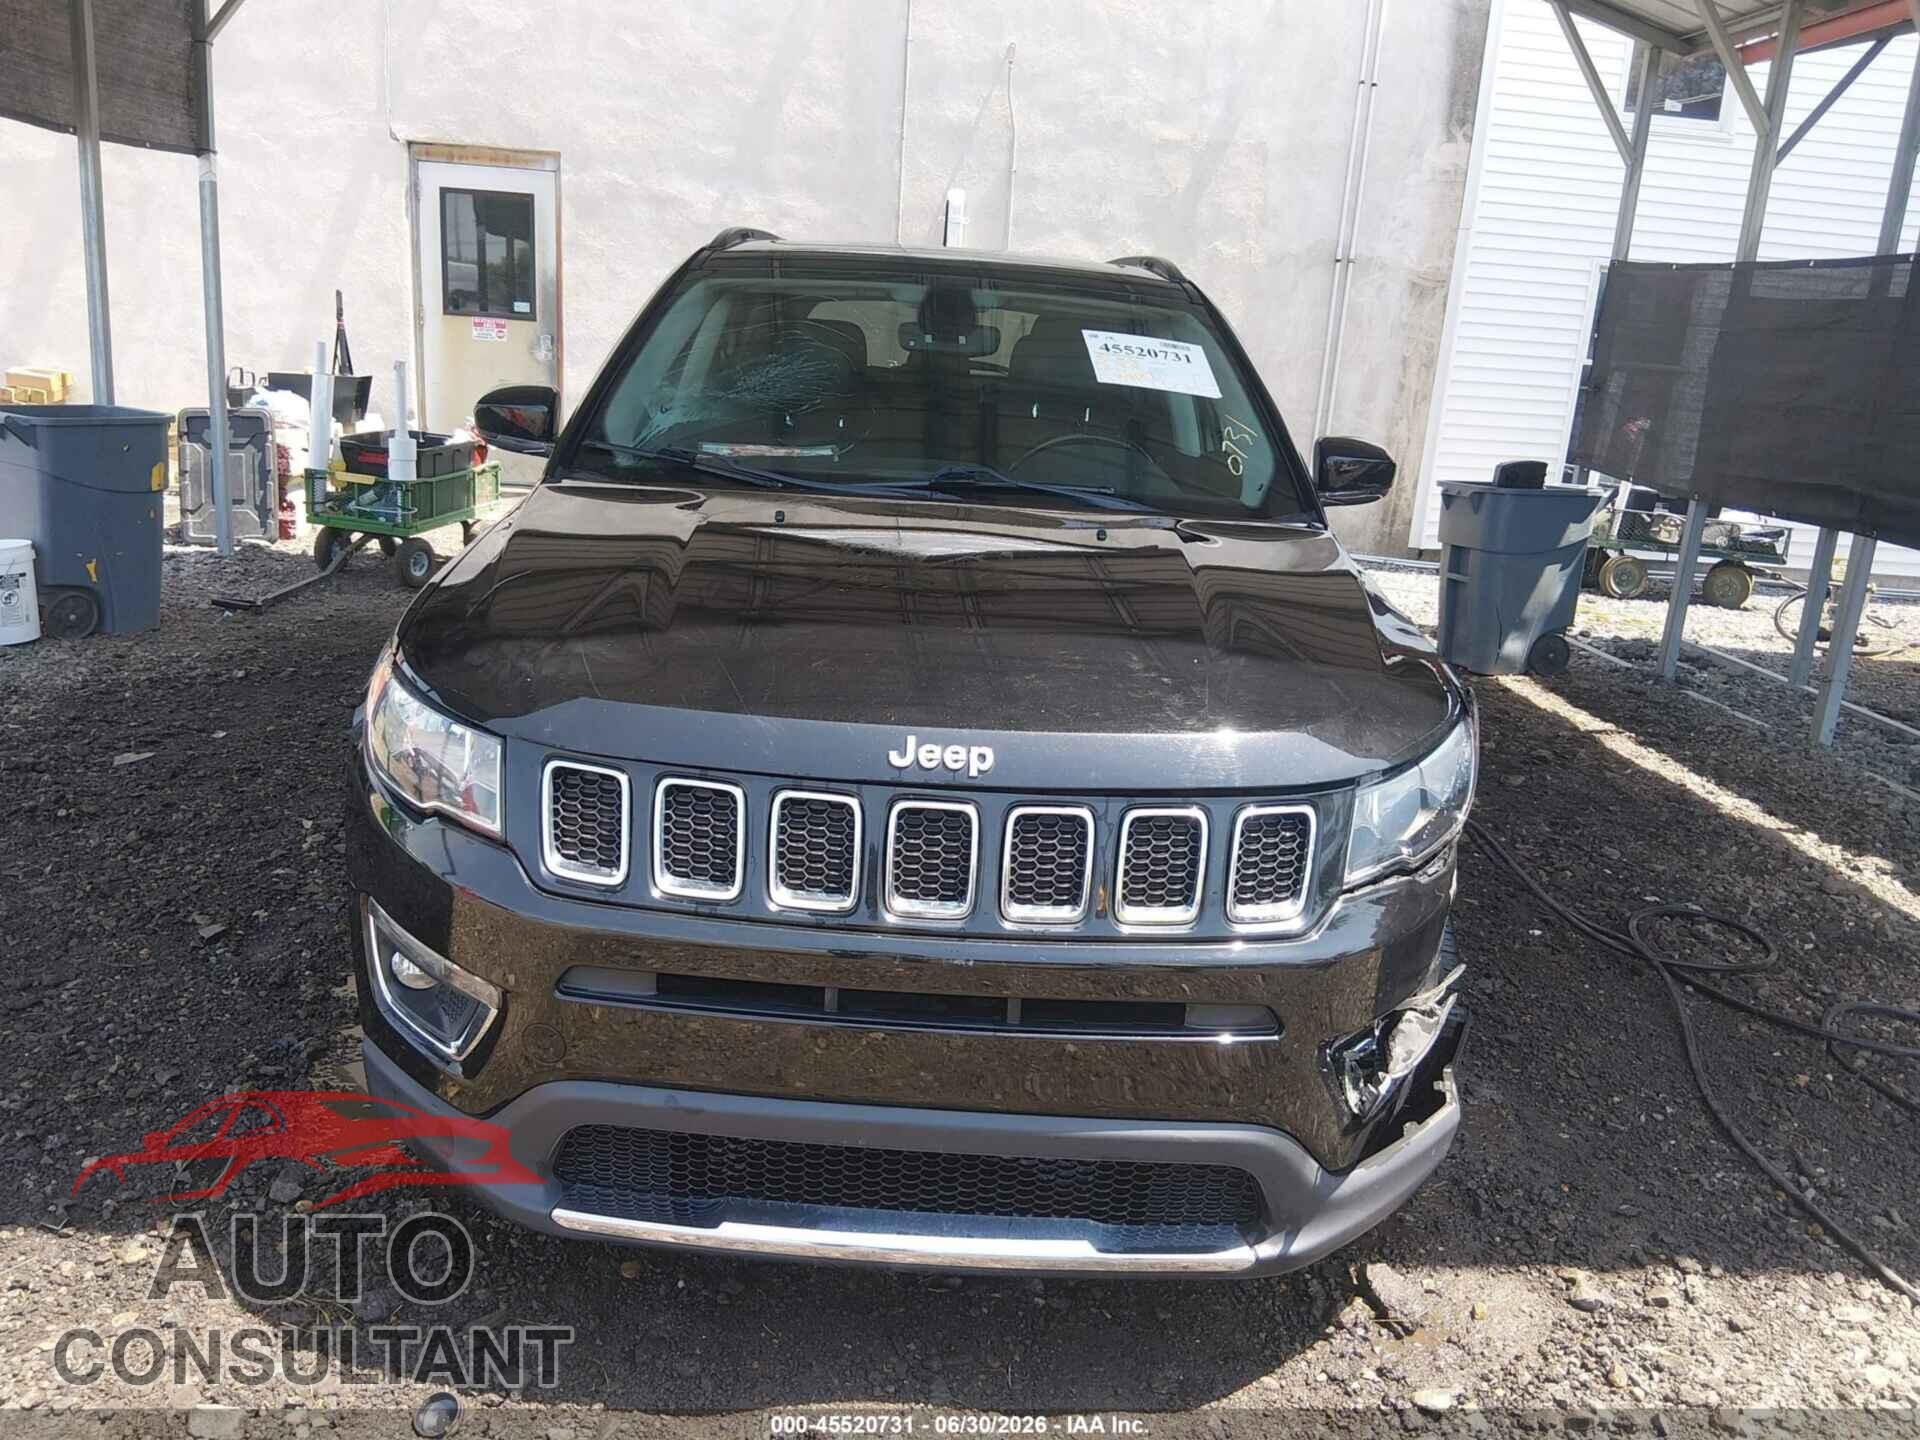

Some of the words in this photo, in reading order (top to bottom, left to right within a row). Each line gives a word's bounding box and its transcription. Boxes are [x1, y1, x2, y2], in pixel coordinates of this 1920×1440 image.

[1100, 342, 1193, 364] 45520731
[1221, 414, 1258, 476] 0731
[887, 734, 994, 777] Jeep
